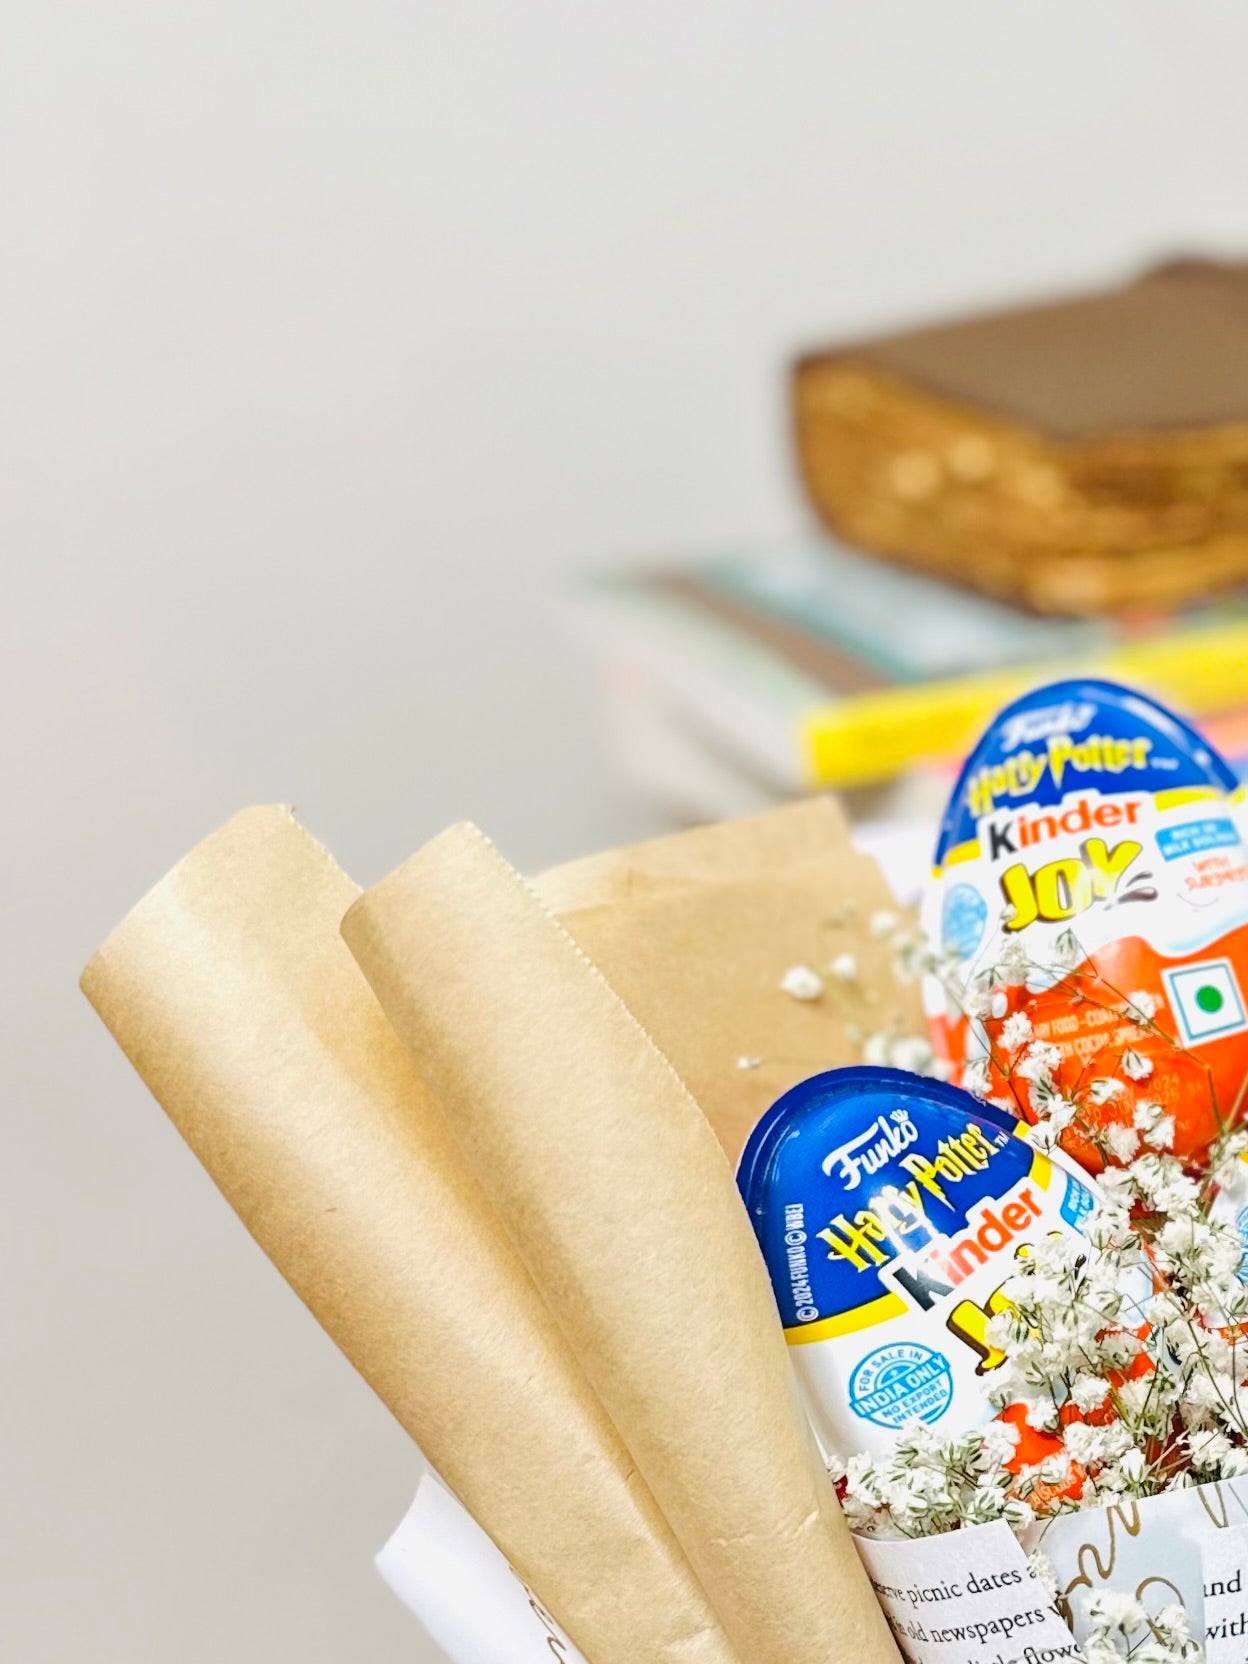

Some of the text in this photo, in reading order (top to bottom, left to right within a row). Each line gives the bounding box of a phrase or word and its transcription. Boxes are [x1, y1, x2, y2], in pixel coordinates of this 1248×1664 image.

[1045, 734, 1153, 790] Potter
[988, 798, 1143, 861] Kinder
[1000, 837, 1143, 932] JOY
[822, 1113, 918, 1190] Funko
[816, 1183, 925, 1273] Harry
[899, 1123, 998, 1212] Potter
[892, 1187, 1043, 1312] Kinder
[854, 1354, 947, 1416] INDIA ONLY
[859, 1349, 923, 1392] FOR SALE IN
[882, 1379, 943, 1418] NO EXPORT
[893, 1388, 948, 1424] INTENDED
[907, 1580, 962, 1609] picnic
[966, 1571, 1022, 1595] dates
[930, 1607, 1046, 1644] newspapers
